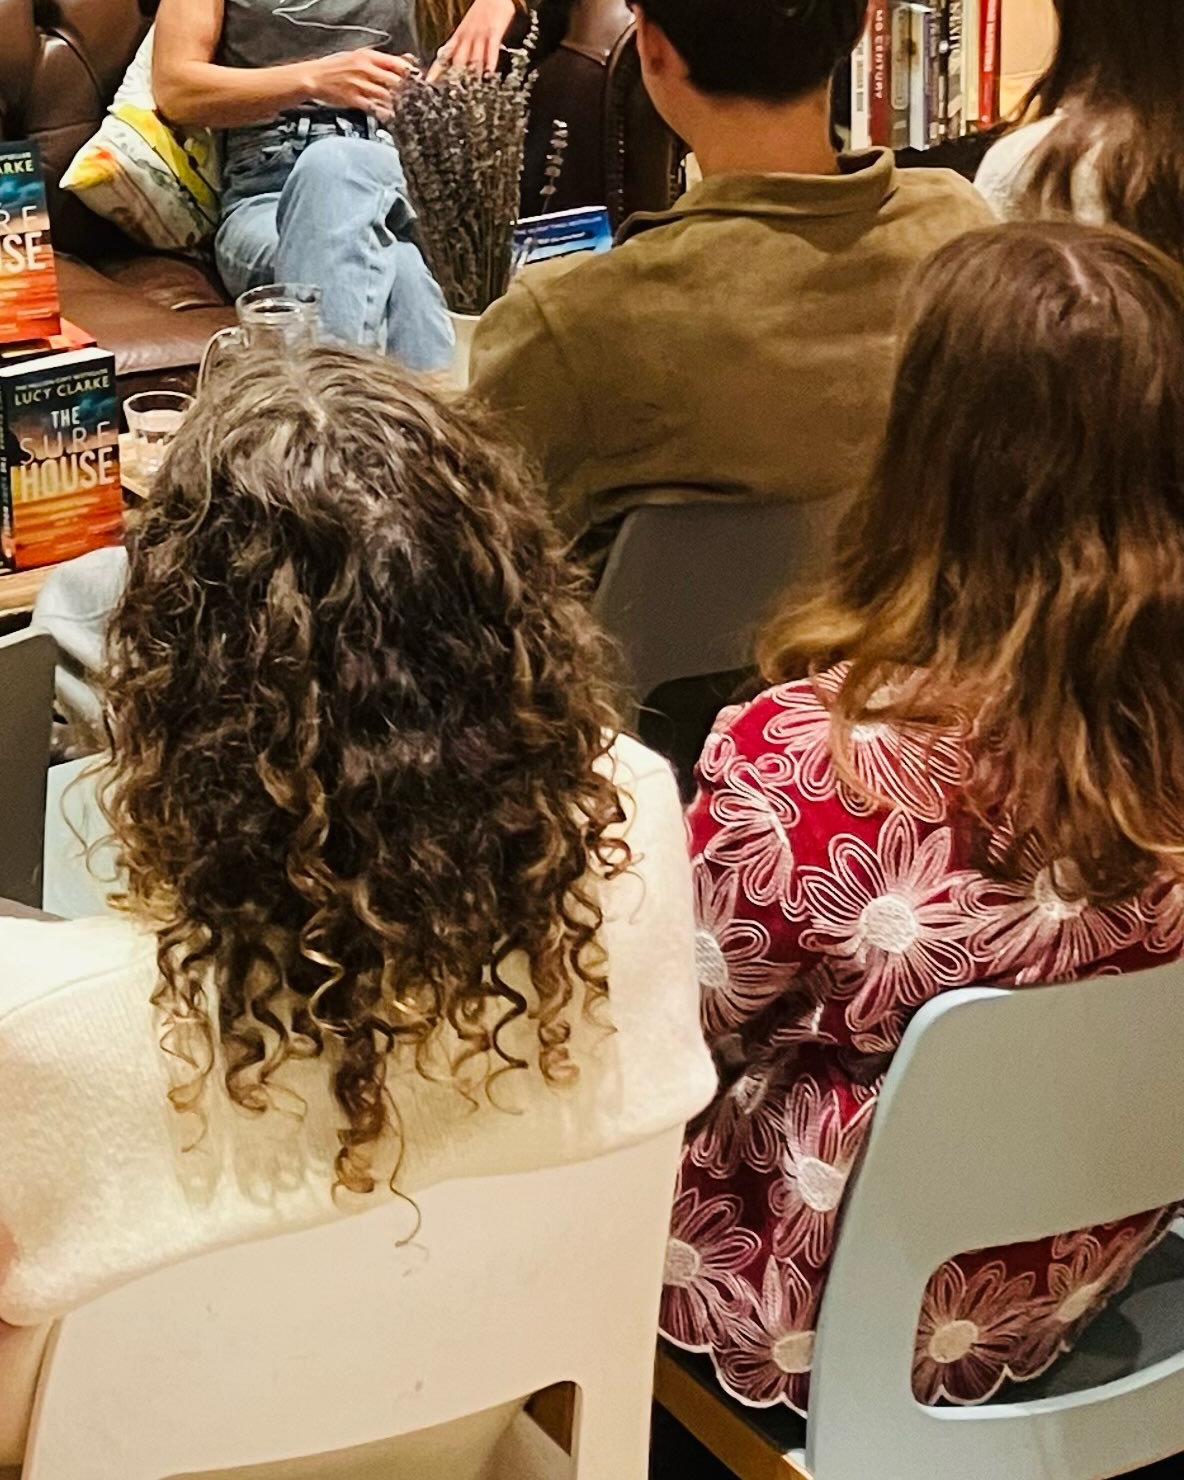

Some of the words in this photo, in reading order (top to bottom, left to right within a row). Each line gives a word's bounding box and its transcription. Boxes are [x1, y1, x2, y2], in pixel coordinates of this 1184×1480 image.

[874, 35, 884, 100] CENTURY
[14, 388, 52, 407] LUCY
[56, 375, 111, 398] CLARKE
[50, 405, 81, 430] THE
[18, 420, 112, 466] SURF
[19, 446, 116, 503] HOUSE
